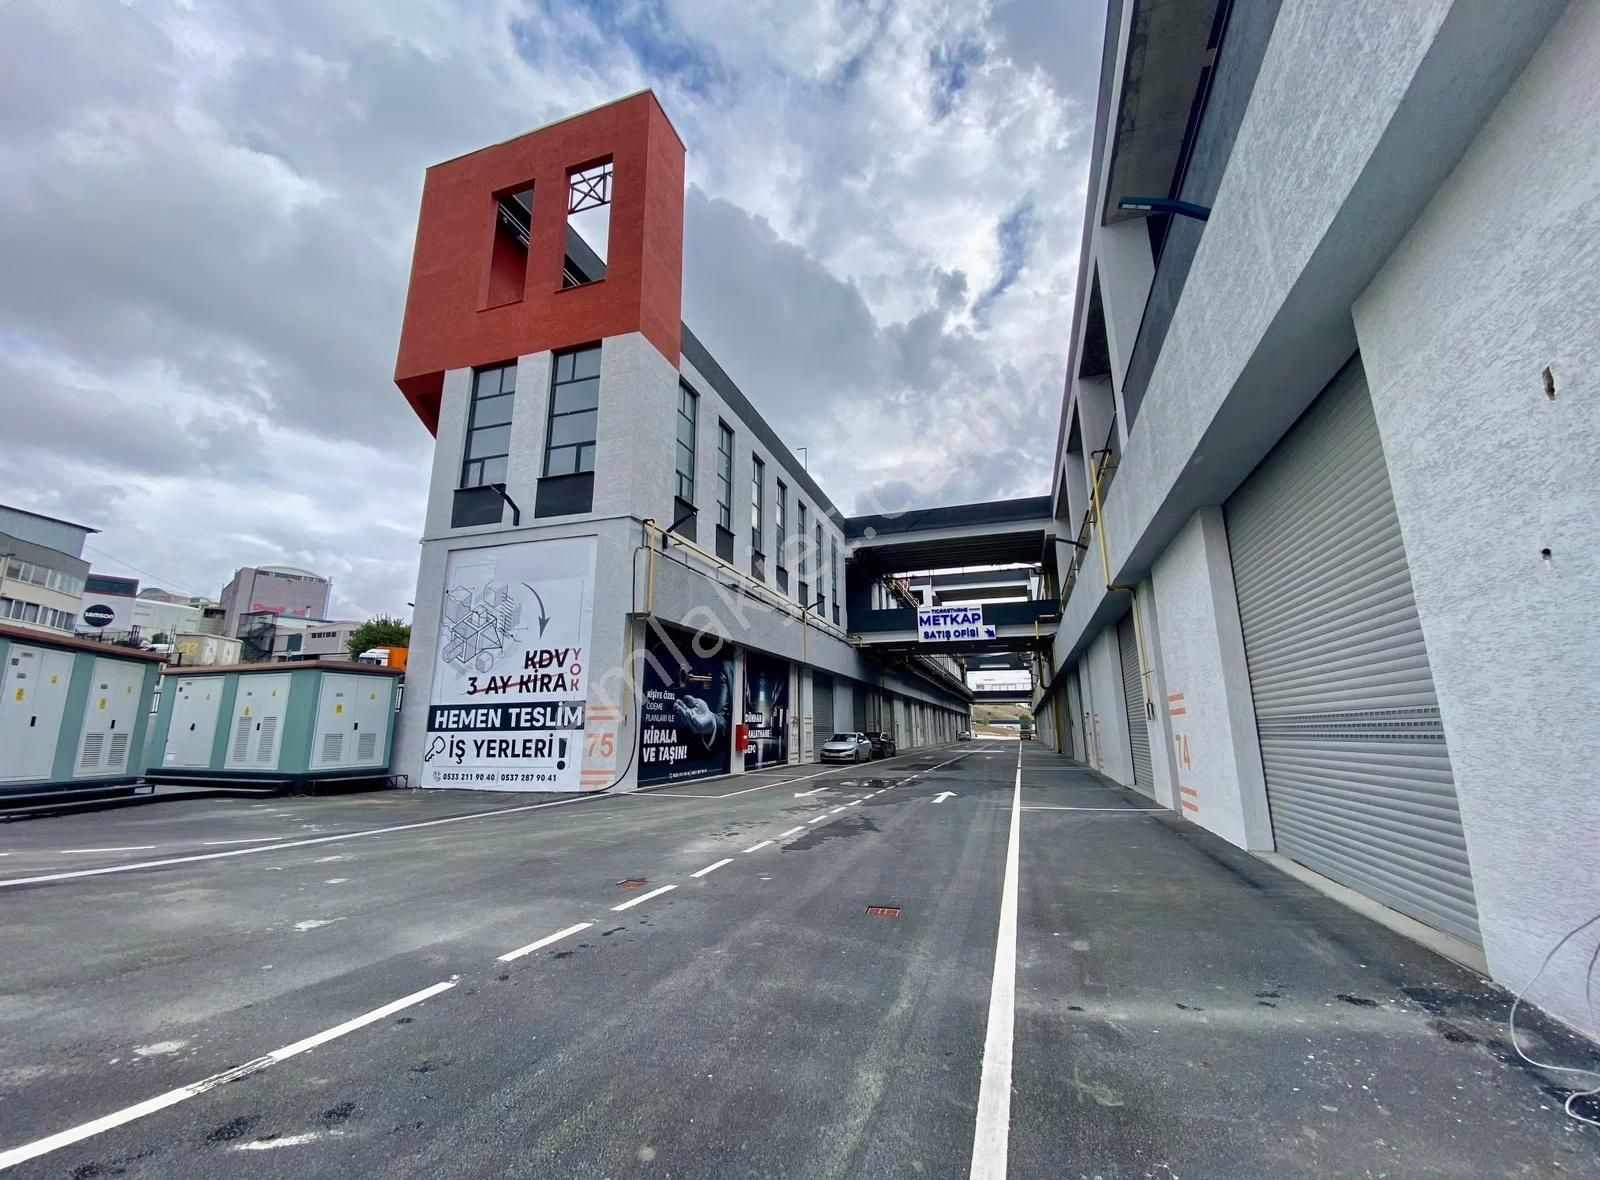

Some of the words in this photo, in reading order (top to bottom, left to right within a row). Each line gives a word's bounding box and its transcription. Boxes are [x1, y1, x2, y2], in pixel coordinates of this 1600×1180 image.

[920, 613, 980, 626] METKAP
[924, 630, 951, 640] SATIŞ
[953, 627, 979, 638] OFİSİ
[524, 648, 570, 669] KDV
[467, 676, 478, 695] 3
[485, 675, 512, 694] AY
[518, 669, 567, 693] KİRA
[434, 708, 502, 728] HEMEN
[508, 701, 583, 728] TESLİM
[586, 732, 614, 757] 75
[643, 725, 677, 744] KİRALA
[449, 734, 466, 764] İŞ
[643, 747, 656, 762] VE
[658, 745, 687, 765] TAŞIN!
[1175, 734, 1191, 770] 74
[443, 773, 459, 781] 0533
